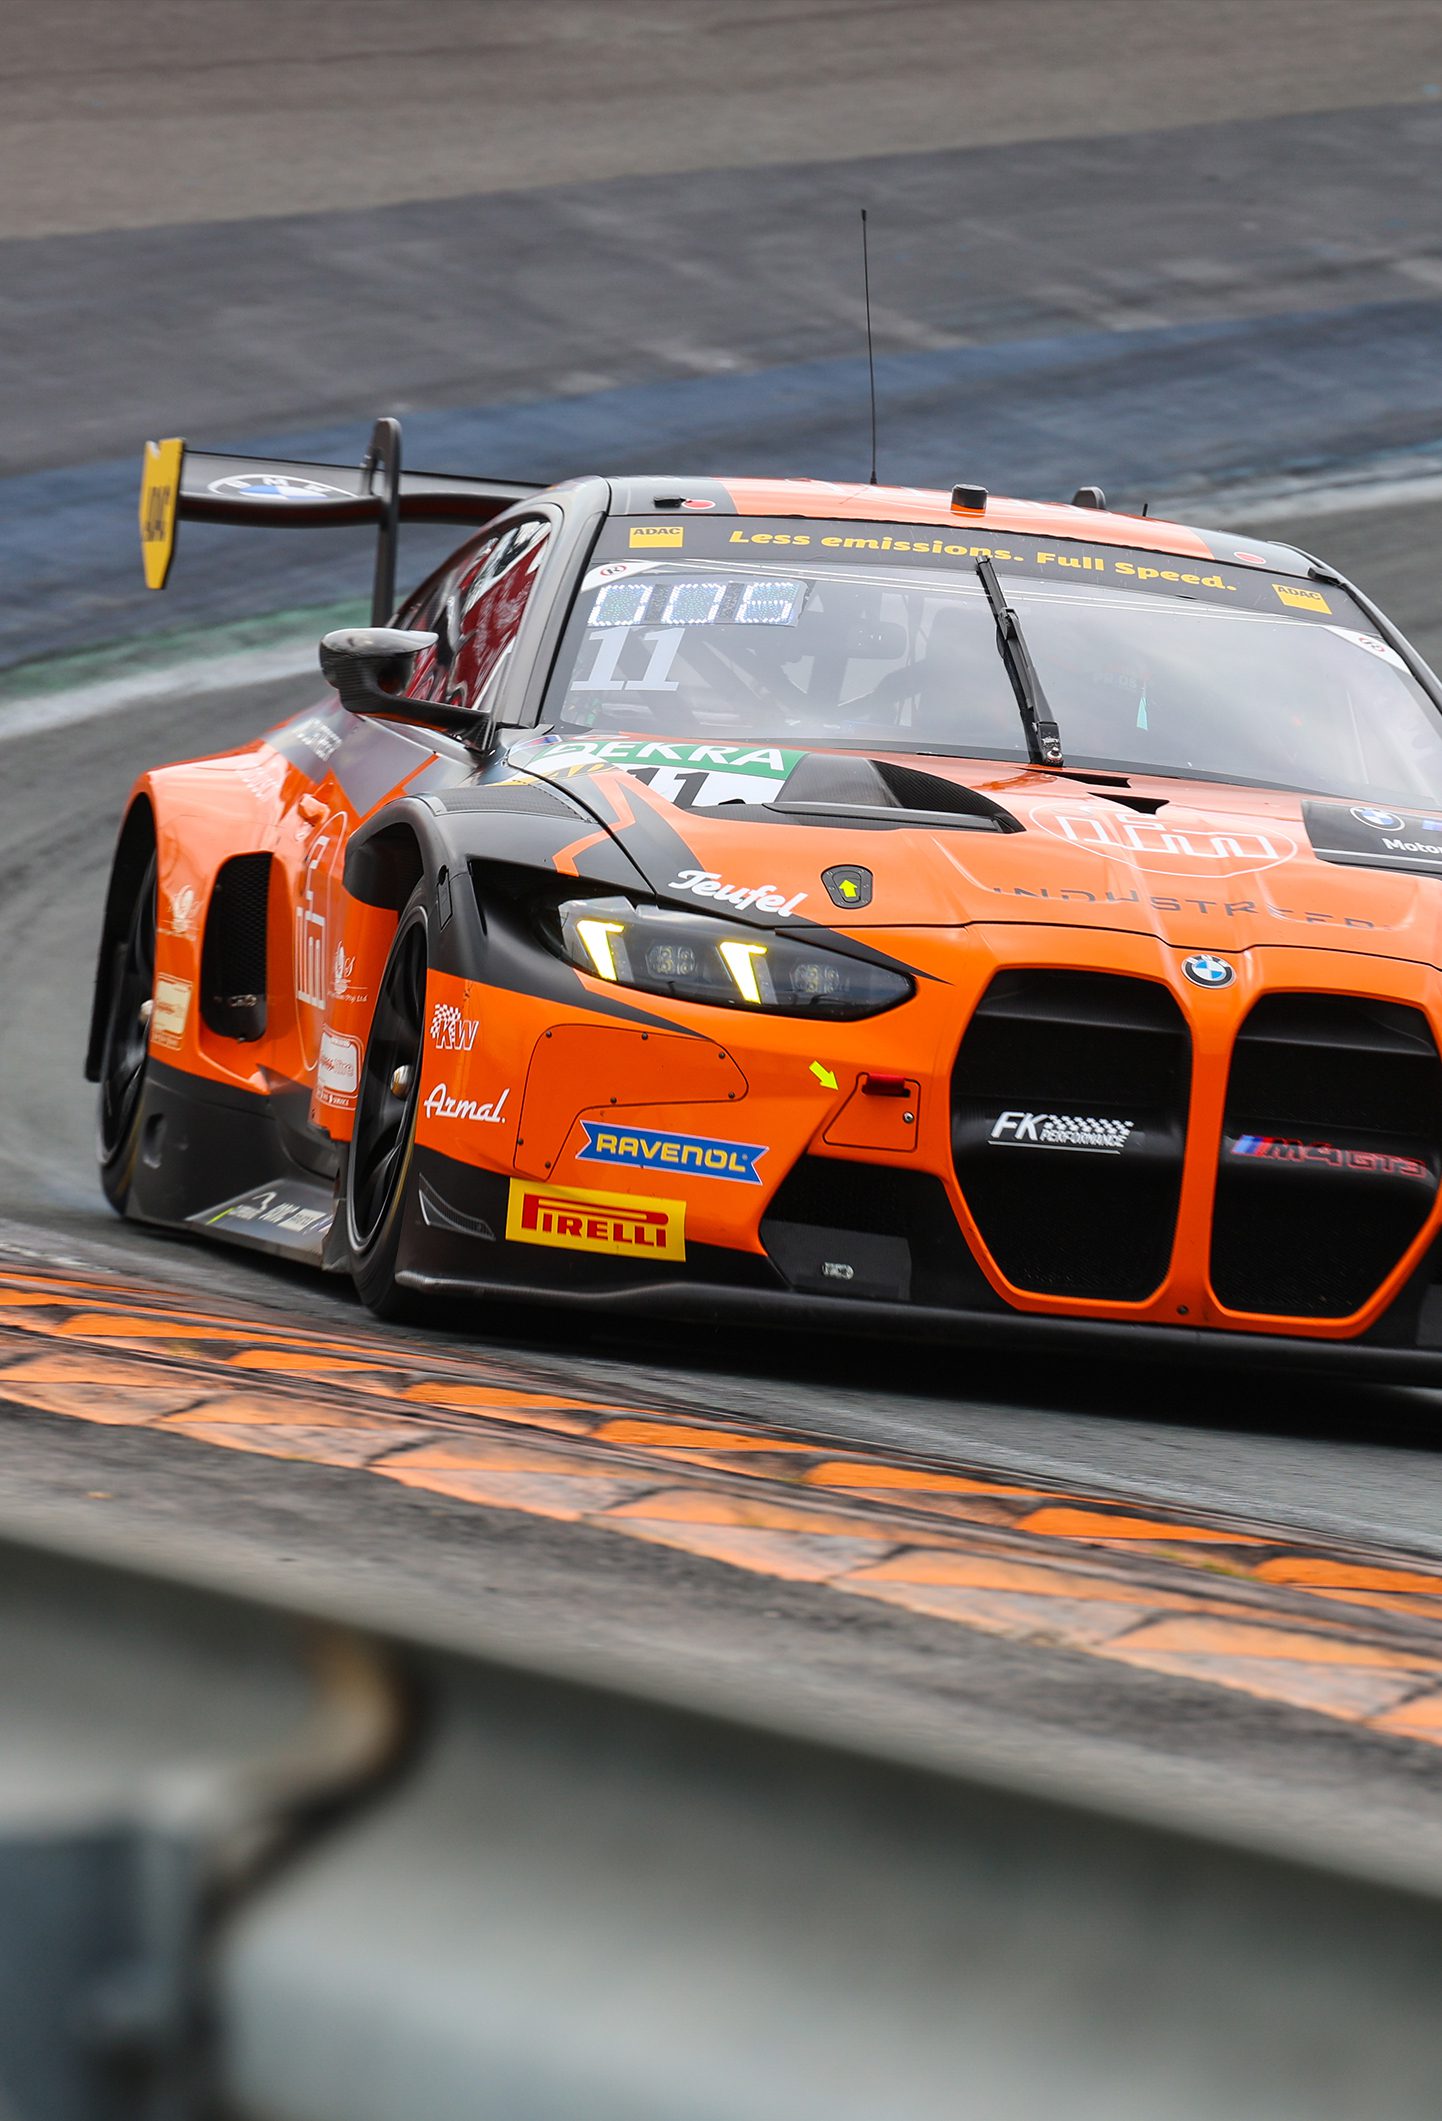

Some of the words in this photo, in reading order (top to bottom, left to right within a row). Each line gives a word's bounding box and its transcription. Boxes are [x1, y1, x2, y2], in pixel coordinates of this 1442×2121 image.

[633, 527, 681, 536] ADAC
[729, 530, 810, 546] Less
[821, 536, 1024, 561] emissions.
[1037, 552, 1104, 571] Full
[1115, 562, 1237, 591] Speed.
[1278, 586, 1321, 600] ADAC
[570, 627, 686, 691] 11
[543, 741, 785, 772] DEKRA
[668, 870, 808, 917] Teufel
[436, 1019, 479, 1051] KW
[991, 1111, 1048, 1141] FK
[1039, 1128, 1127, 1148] PERFORMANCE
[596, 1133, 746, 1172] RAVENOL
[521, 1194, 669, 1248] PIRELLI
